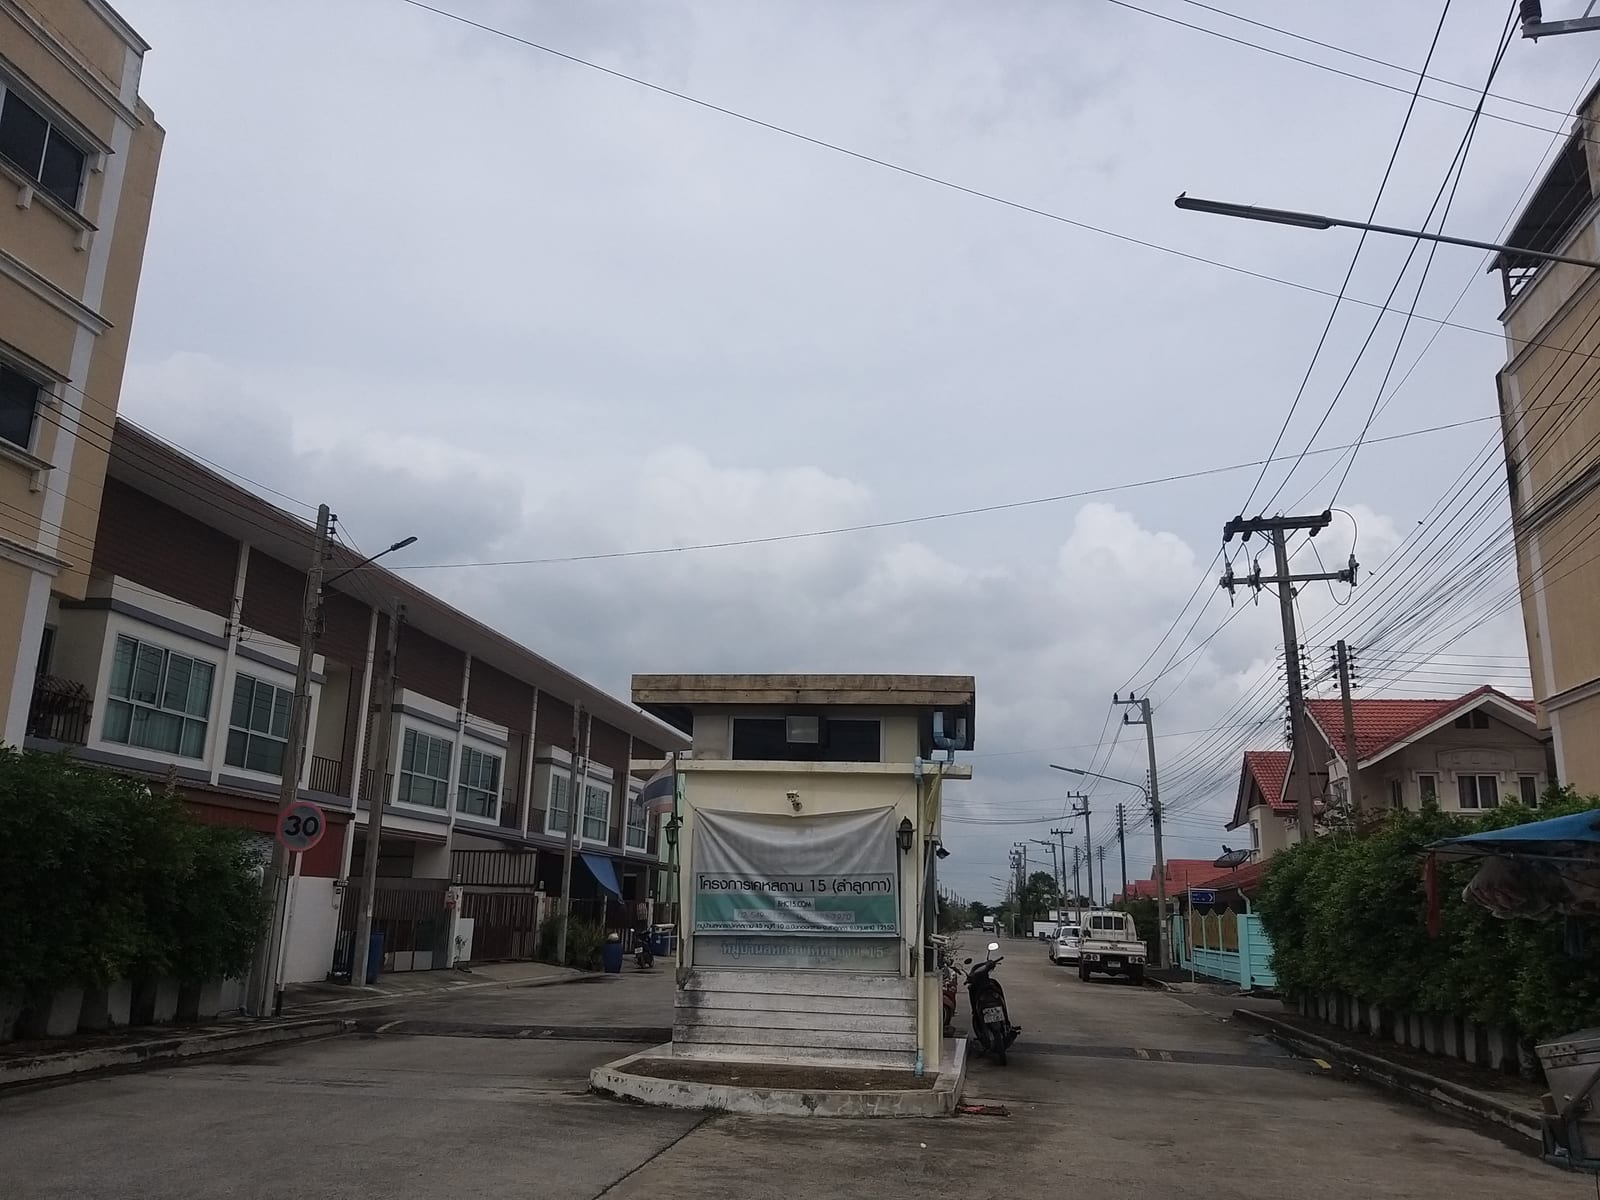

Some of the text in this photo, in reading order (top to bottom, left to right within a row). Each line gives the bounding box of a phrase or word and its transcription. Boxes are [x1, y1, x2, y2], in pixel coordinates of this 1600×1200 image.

[284, 815, 320, 836] 30
[699, 875, 804, 892] โครงการเคหสถาน
[810, 879, 827, 892] 15
